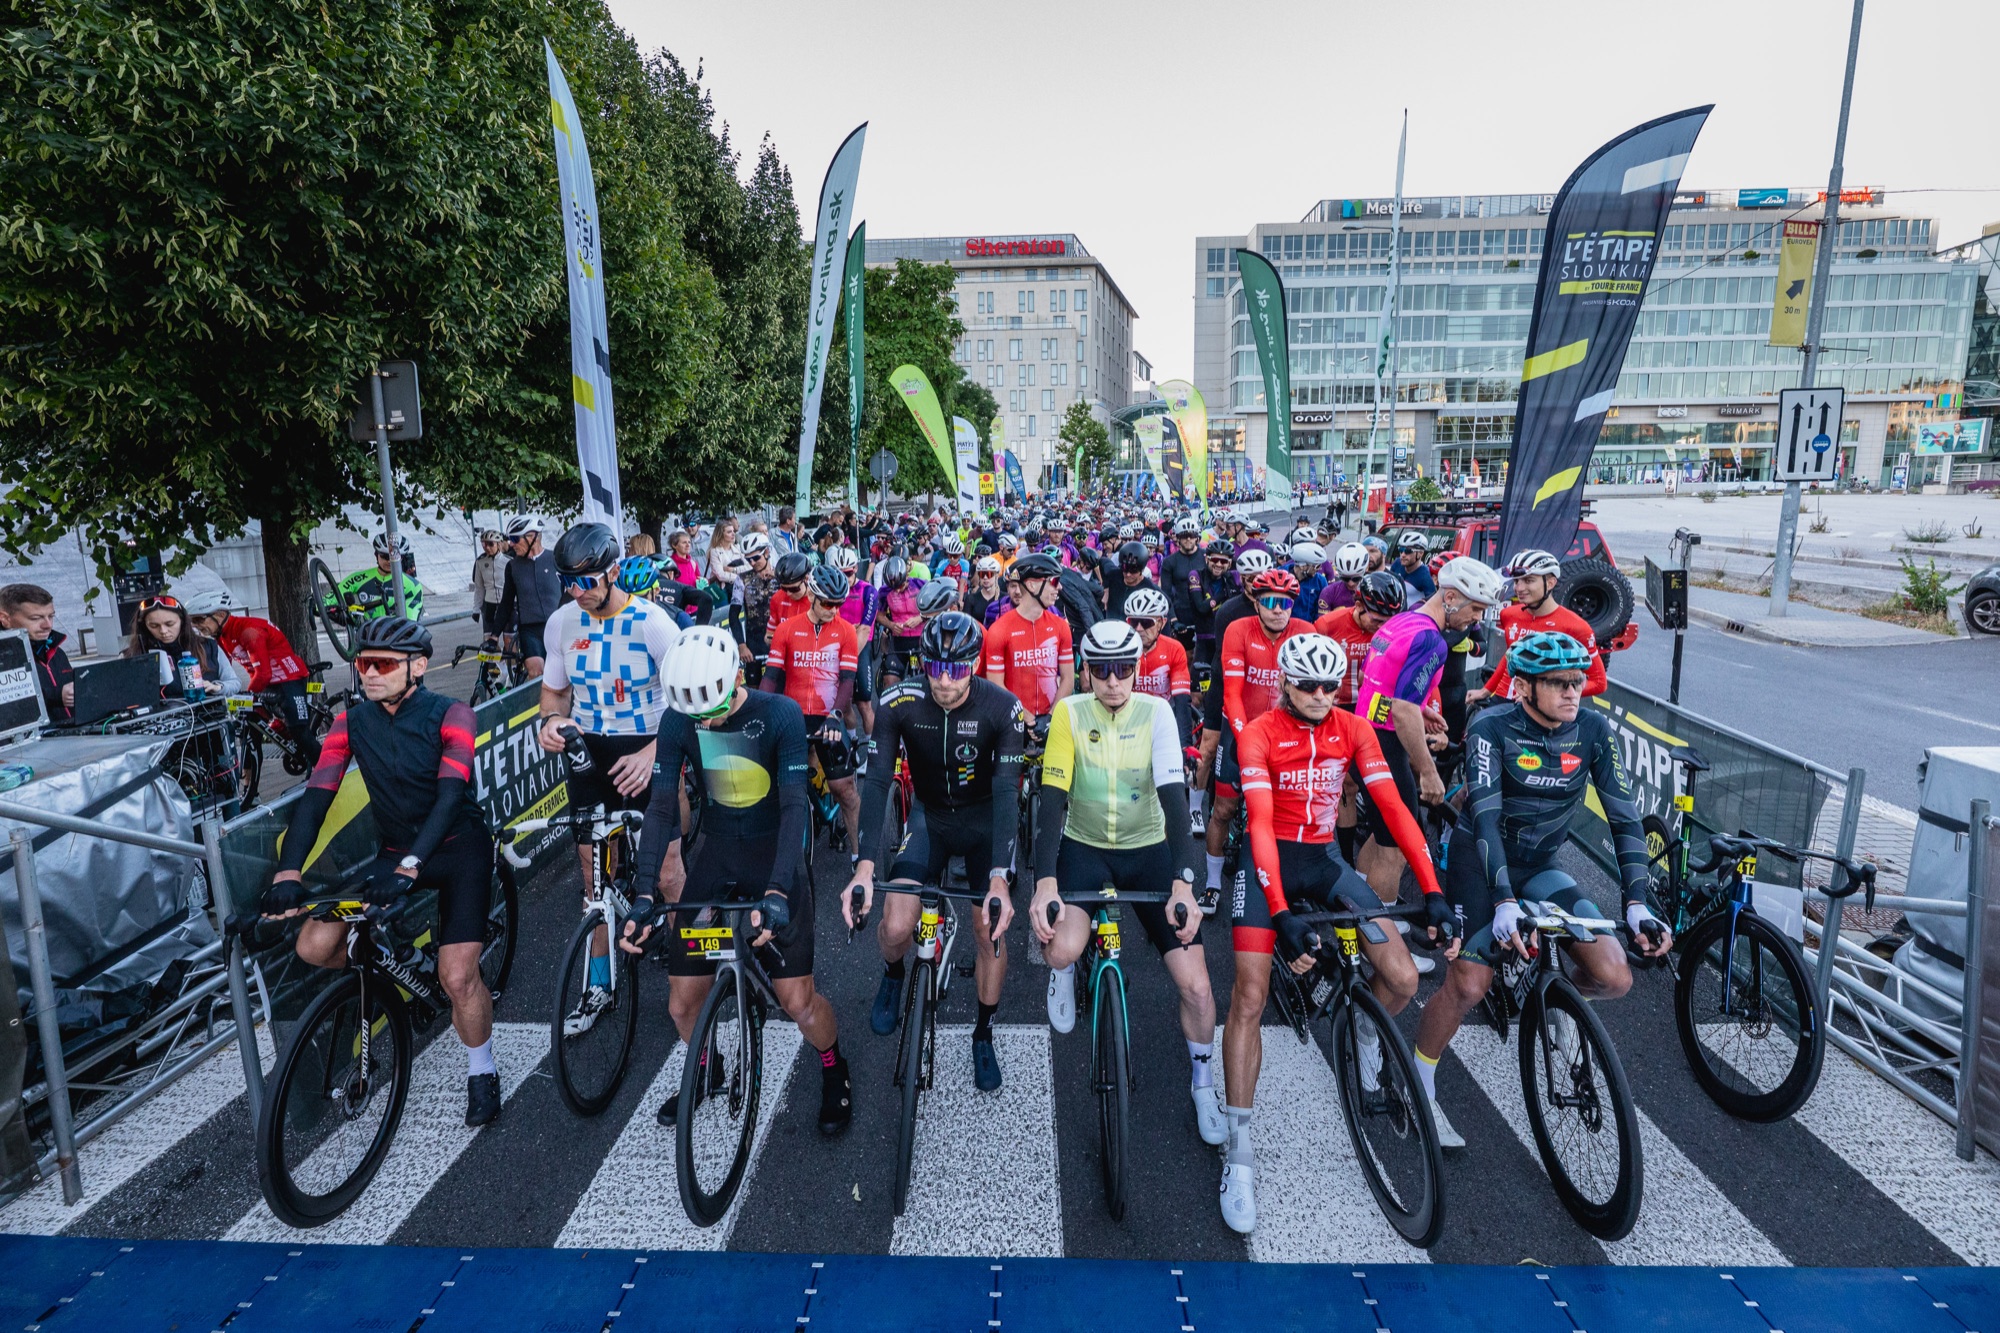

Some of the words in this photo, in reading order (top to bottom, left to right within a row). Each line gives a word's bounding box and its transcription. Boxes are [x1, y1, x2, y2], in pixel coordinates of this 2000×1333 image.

[1366, 202, 1423, 215] Metife
[1786, 223, 1817, 236] BILLA
[965, 238, 1065, 257] Sheraton
[1787, 238, 1813, 246] EUROVEA
[1561, 263, 1647, 280] SLOVAKIA
[1784, 306, 1794, 314] 30
[1720, 407, 1760, 415] PRIMARK
[343, 572, 368, 590] uvex
[793, 651, 838, 662] PIERRE
[1014, 645, 1057, 661] PIERRE
[0, 670, 27, 686] UND
[257, 720, 298, 754] FOCUS
[1215, 745, 1224, 777] PIERRE
[1478, 737, 1491, 788] BMC
[1518, 758, 1539, 766] CIBEL
[1279, 767, 1342, 784] PIERRE
[1524, 774, 1570, 787] BMC
[543, 787, 566, 815] FRANCE
[592, 844, 602, 900] TREK
[1736, 862, 1756, 876] 414
[1236, 869, 1246, 918] PIERRE
[698, 938, 720, 951] 149
[1103, 934, 1121, 950] 299
[1549, 942, 1559, 967] BMC
[376, 953, 431, 998] SPECIALIZED
[1311, 975, 1333, 1007] PIERRE
